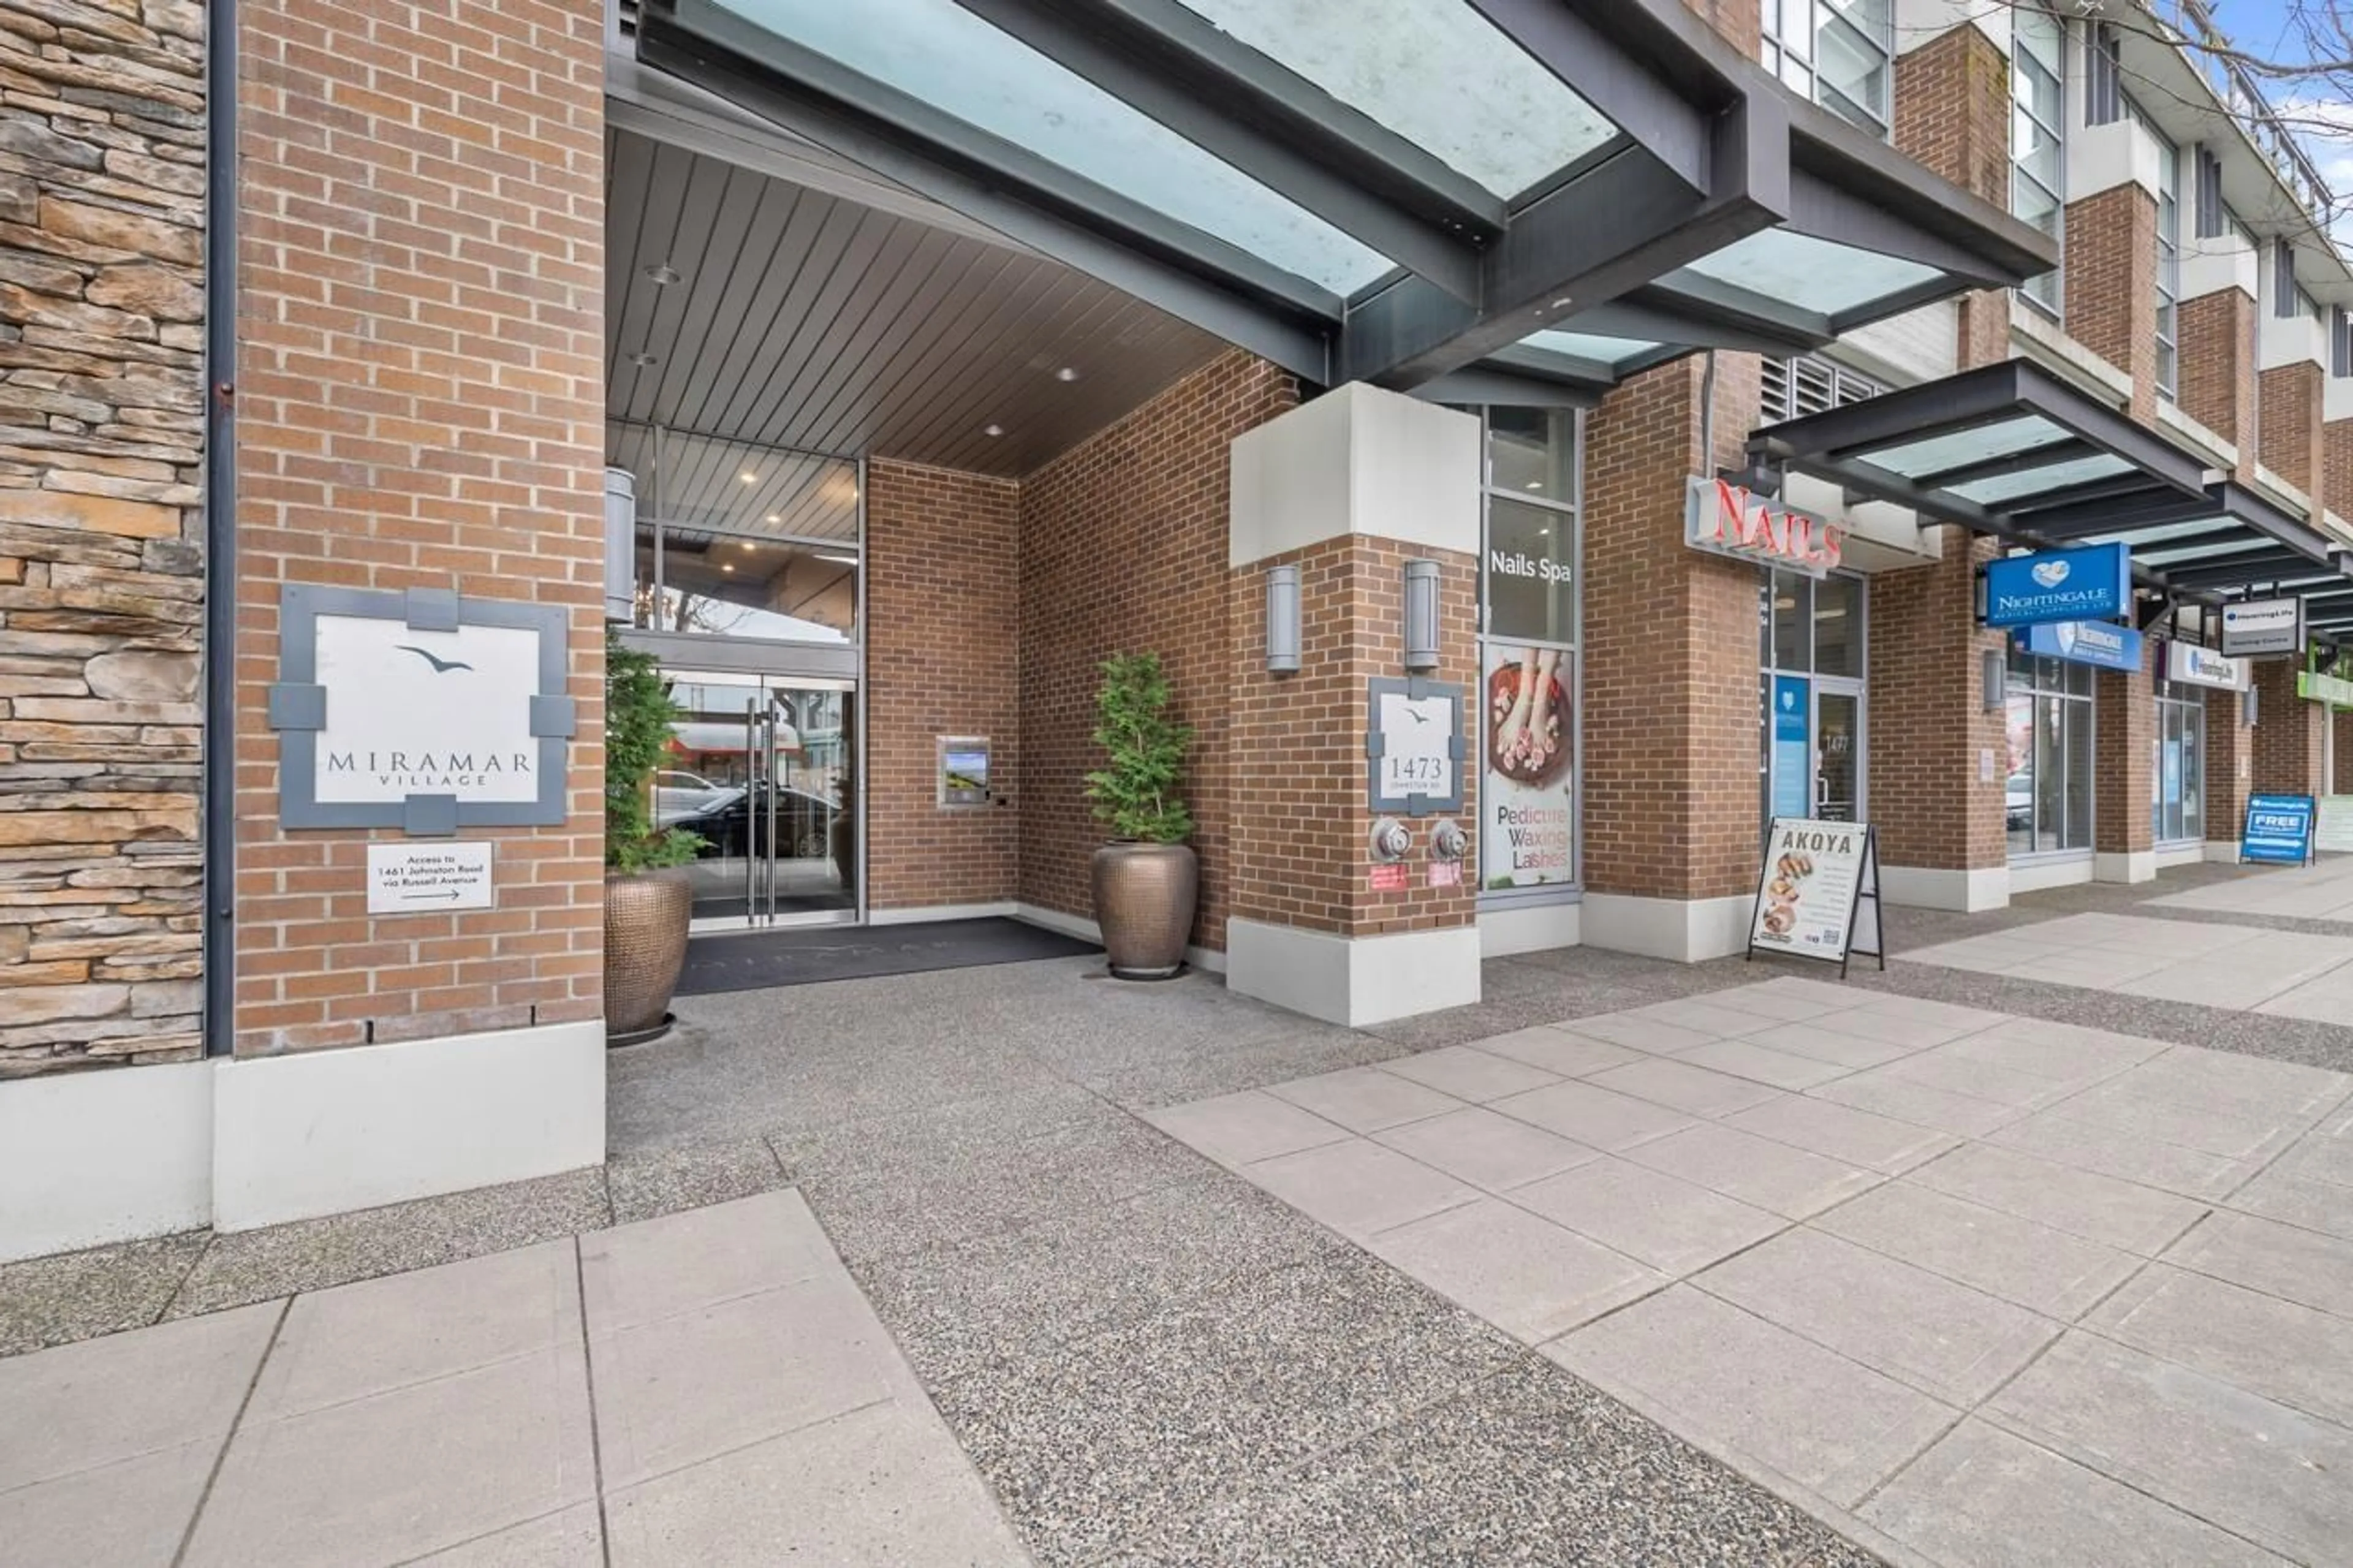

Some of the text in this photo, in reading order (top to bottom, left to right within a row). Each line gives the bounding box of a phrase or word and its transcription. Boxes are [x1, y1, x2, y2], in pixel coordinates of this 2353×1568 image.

[1491, 550, 1571, 586] Nails Spa
[1999, 588, 2108, 610] NIGHTINGALE
[328, 751, 531, 772] MIRAMAR
[1392, 757, 1442, 779] 1473
[380, 775, 487, 786] VILLAGE
[1498, 805, 1567, 825] Pedicure
[2256, 816, 2299, 827] FREE
[1509, 828, 1567, 850] Waxing
[1781, 830, 1851, 854] AKOYA
[407, 855, 442, 865] Access
[1513, 850, 1567, 869] Lashes
[378, 864, 484, 876] 1461 Johnston Road
[382, 876, 479, 887] via Russell Avenue
